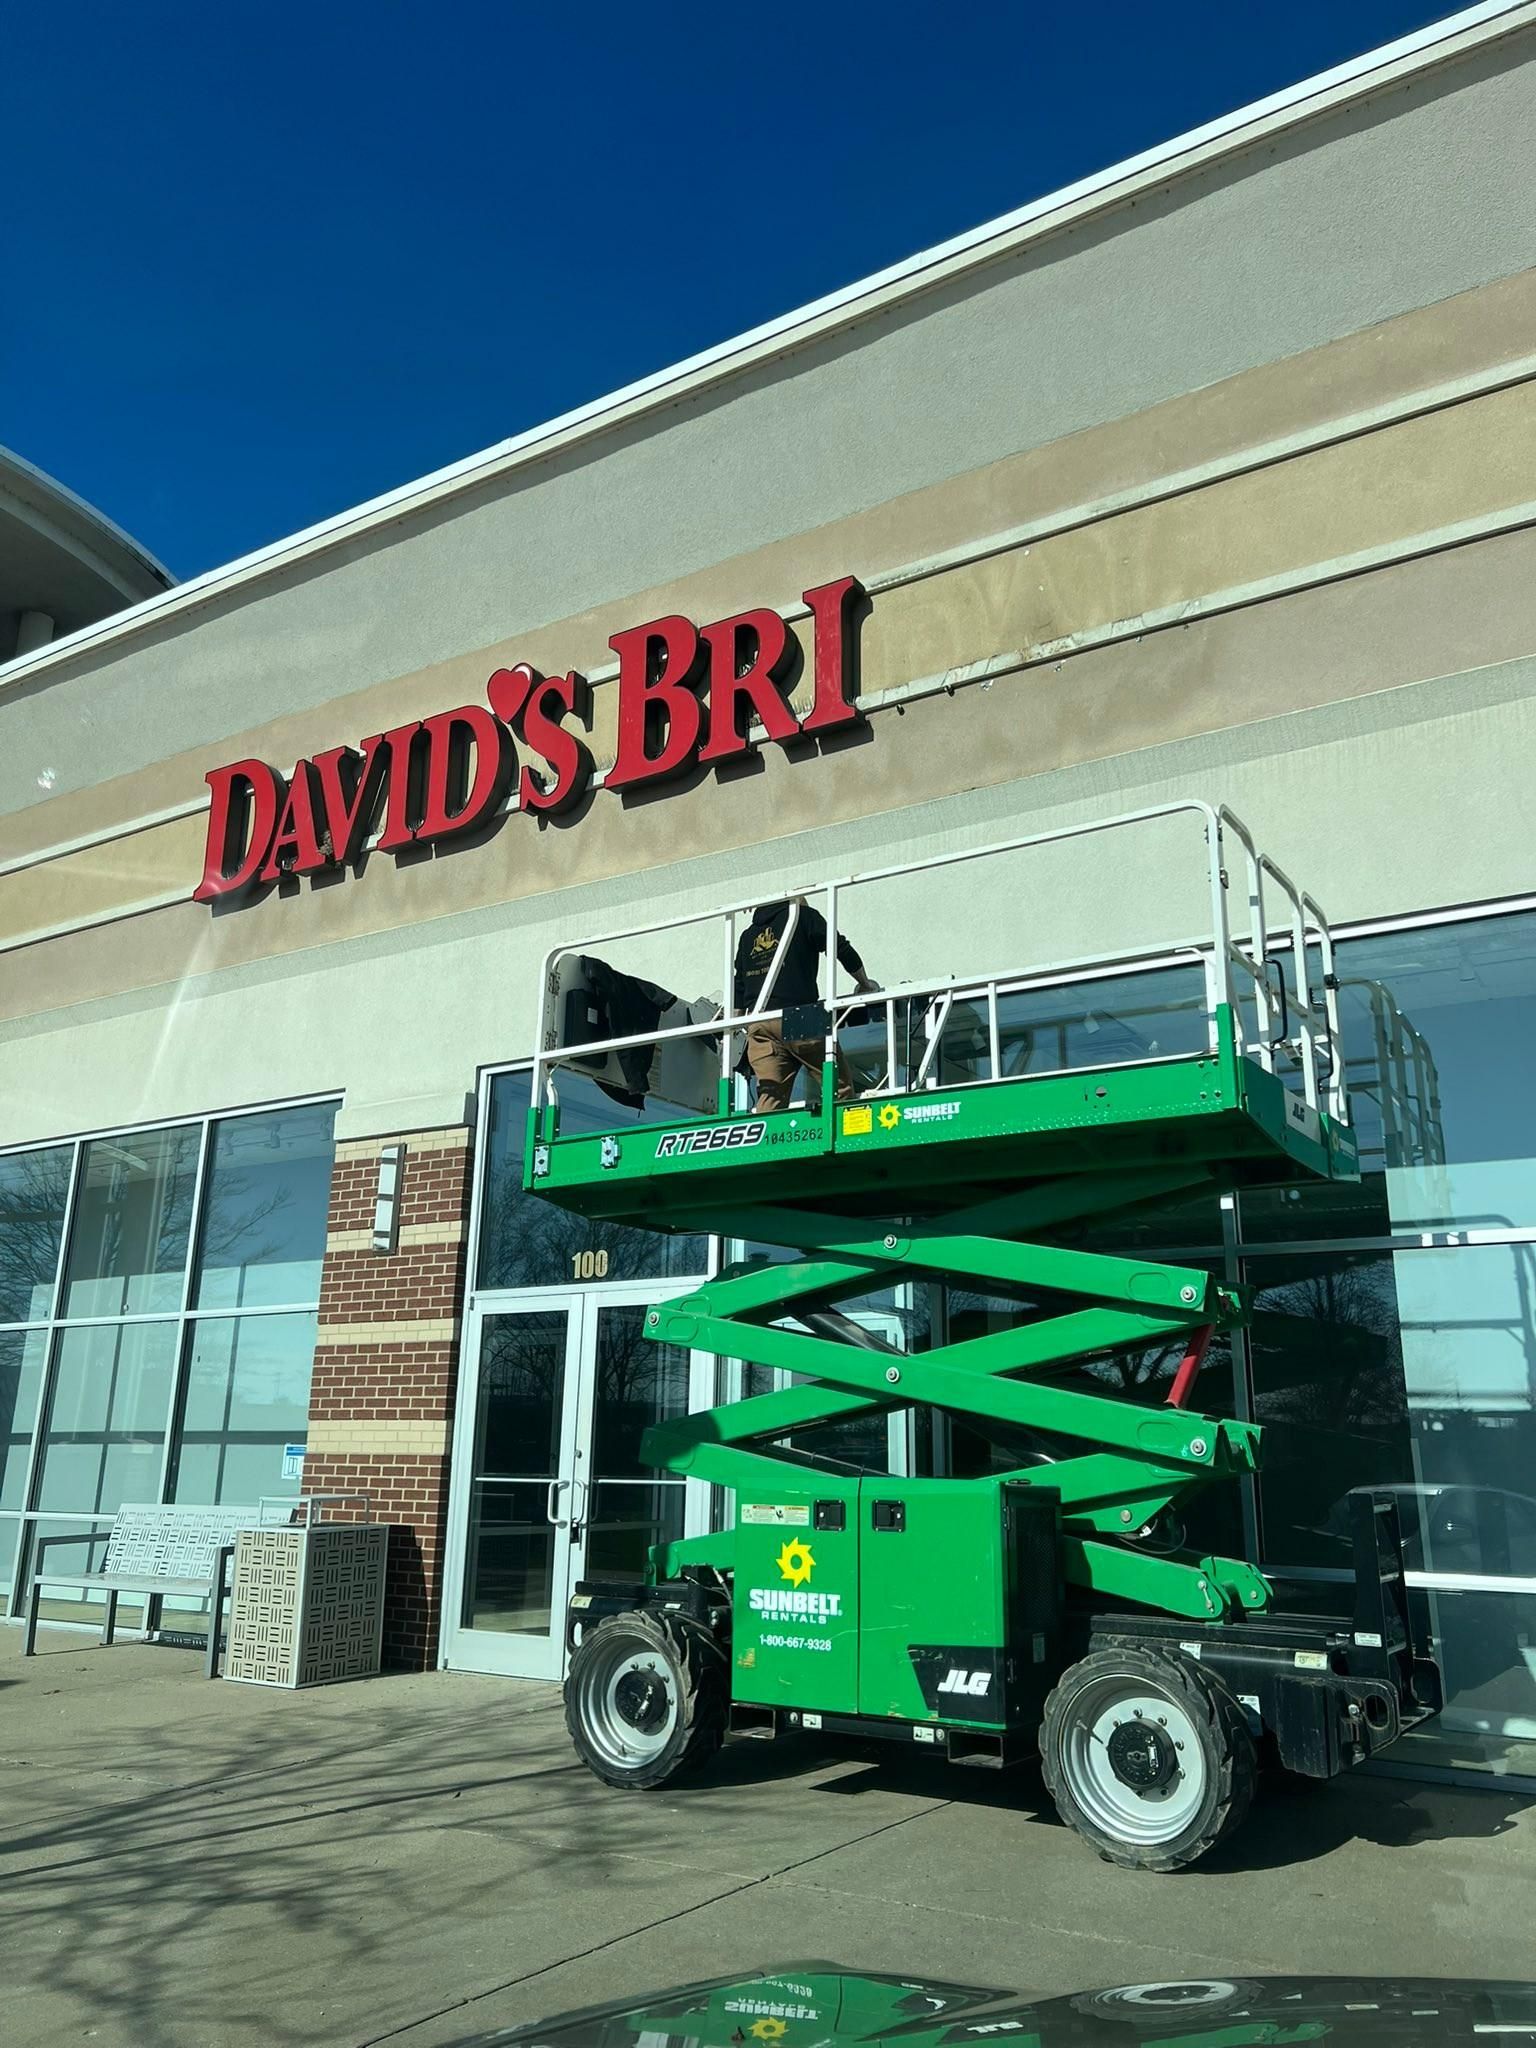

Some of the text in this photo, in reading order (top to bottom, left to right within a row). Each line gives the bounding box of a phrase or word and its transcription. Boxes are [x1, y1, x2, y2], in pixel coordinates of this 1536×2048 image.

[194, 576, 866, 901] DAVID'S BRI
[904, 1102, 961, 1119] SUNBELT
[912, 1115, 952, 1123] RENTALS
[655, 1121, 766, 1157] RT2669
[765, 1128, 824, 1145] 10435262
[572, 1250, 608, 1278] 100
[749, 1588, 841, 1616] SUNBELT
[761, 1611, 827, 1624] RENTALS
[760, 1633, 832, 1651] 1-800-667-9328
[937, 1669, 992, 1696] JLG
